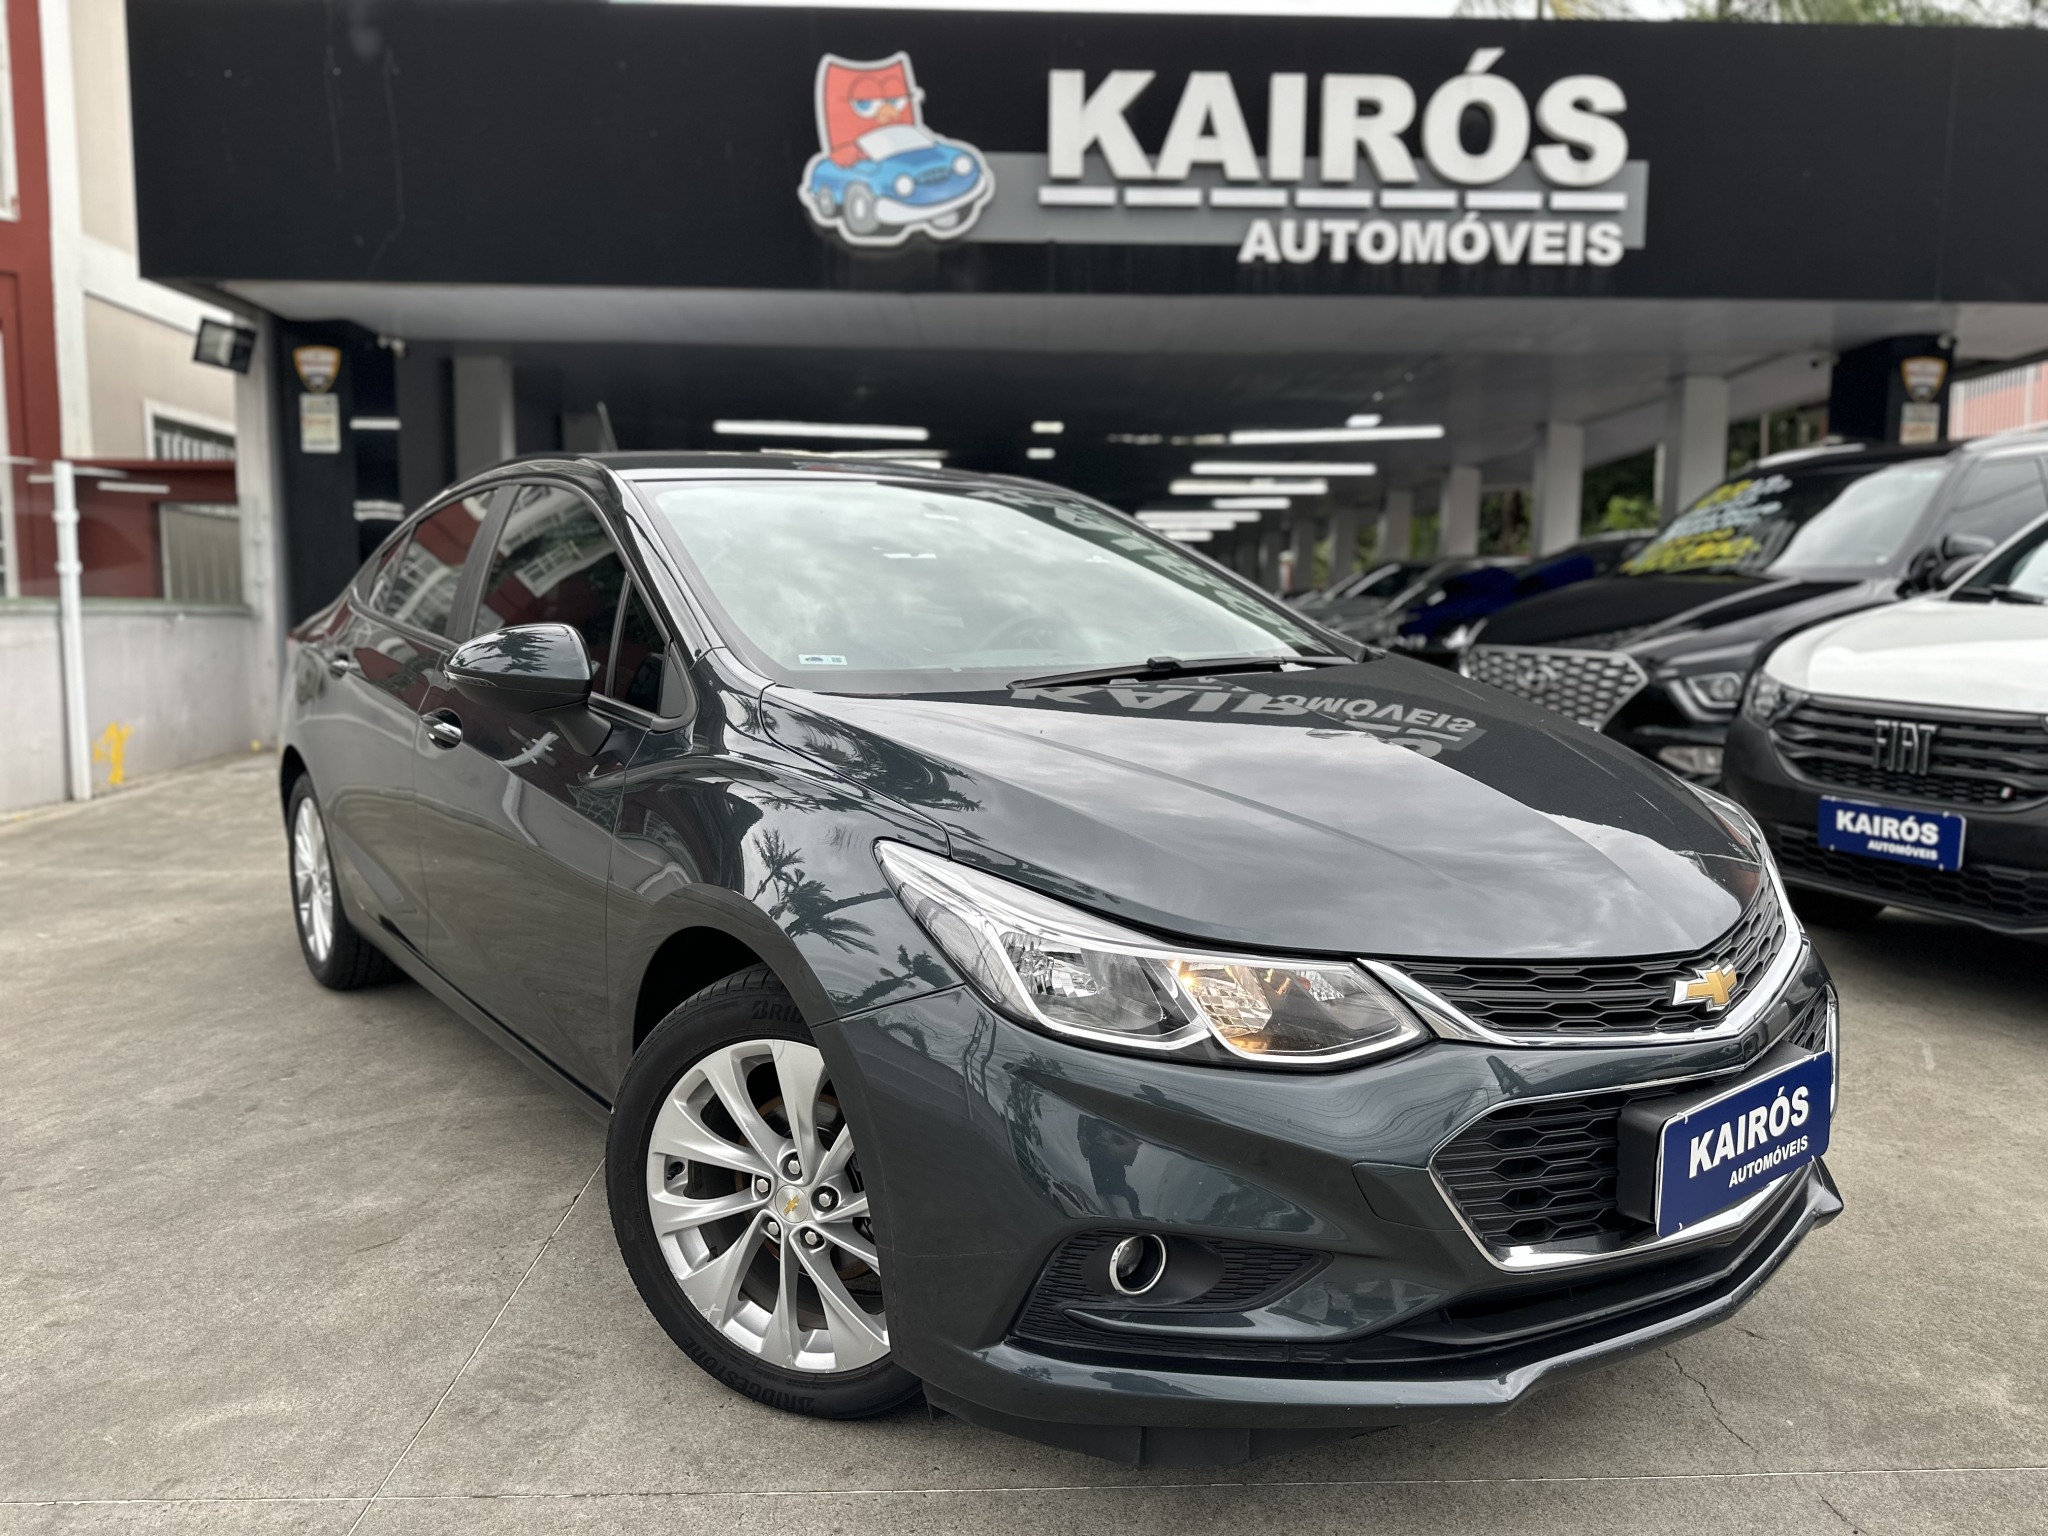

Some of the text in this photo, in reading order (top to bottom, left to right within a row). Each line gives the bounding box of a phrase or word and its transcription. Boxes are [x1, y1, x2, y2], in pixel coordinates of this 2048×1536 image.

[1049, 48, 1627, 187] KAIRÓS
[1238, 212, 1623, 266] AUTOMÓVEIS
[1872, 719, 1939, 776] FIAT
[1836, 809, 1940, 845] KAIRÓS
[1867, 840, 1939, 861] AUTOMÓVEIS
[751, 1000, 804, 1024] BRID
[1689, 1085, 1809, 1179] KAIRÓS
[1729, 1135, 1809, 1188] AUTOMÓVEIS
[681, 1335, 815, 1414] BRIDGESTONE
